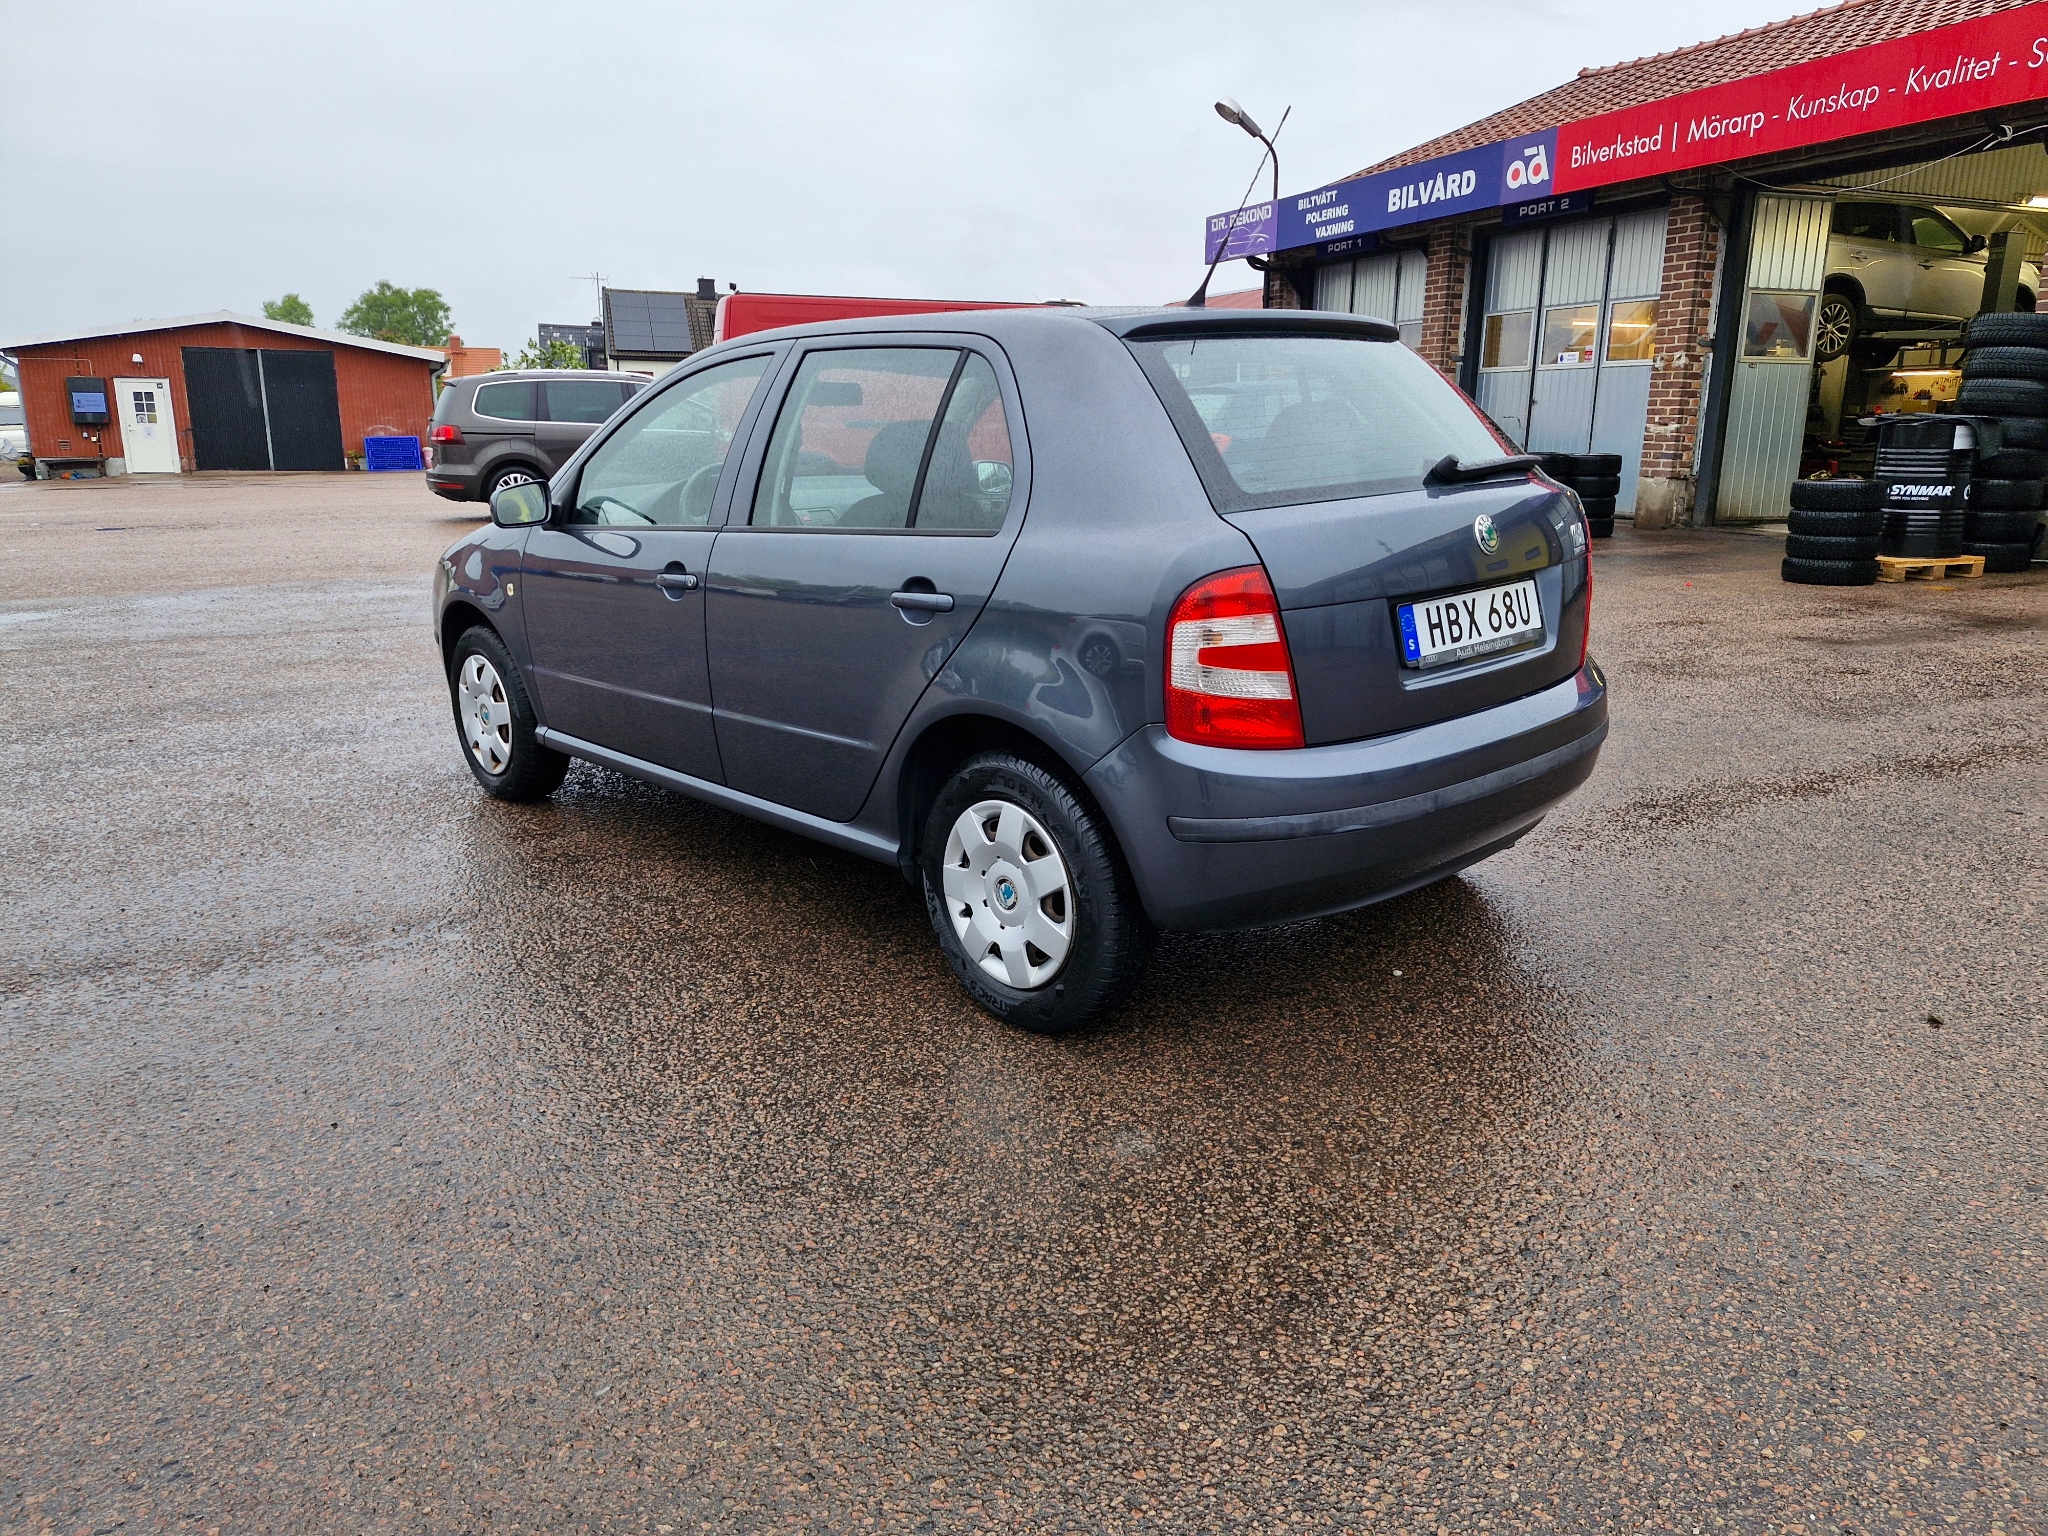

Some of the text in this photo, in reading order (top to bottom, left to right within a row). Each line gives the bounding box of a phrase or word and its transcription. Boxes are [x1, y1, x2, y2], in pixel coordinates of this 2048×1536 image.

[1570, 123, 1664, 169] Bilverkstad
[1686, 110, 1766, 144] Mörarp
[1785, 82, 1880, 122] Kunskap
[1904, 50, 2002, 96] Kvalitet
[2027, 36, 2048, 69] S
[1386, 169, 1477, 213] BILVÅRD
[1305, 203, 1349, 225] POLERING
[1519, 197, 1570, 218] PORT 2
[1211, 204, 1272, 233] DR. REKOND
[1315, 219, 1355, 239] VAXNING
[1327, 238, 1363, 254] PORT 1
[1425, 586, 1531, 648] HBX 68U
[1408, 638, 1416, 651] S
[1456, 637, 1513, 658] Audi Helsingborg
